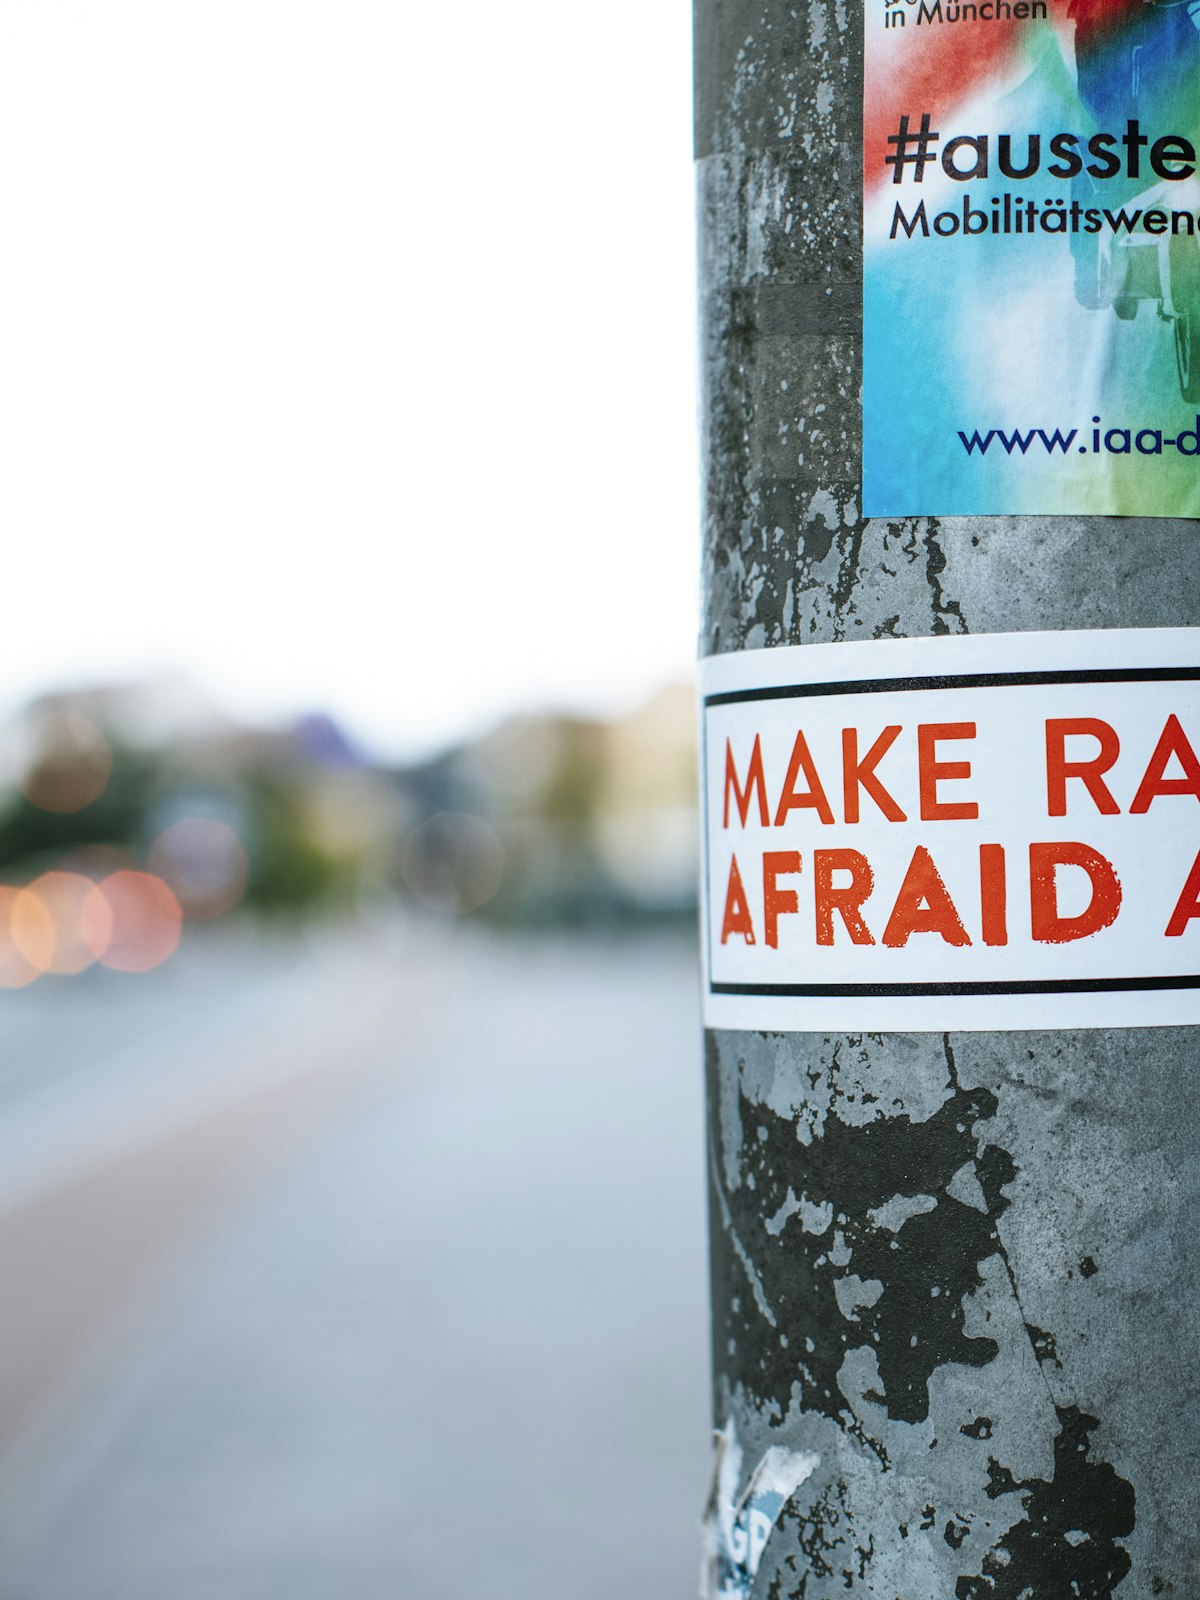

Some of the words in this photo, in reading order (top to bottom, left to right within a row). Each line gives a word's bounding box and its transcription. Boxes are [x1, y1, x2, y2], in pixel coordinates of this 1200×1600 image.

[884, 4, 906, 29] in
[916, 0, 1048, 26] München
[722, 721, 979, 830] MAKE
[720, 841, 1123, 949] AFRAID
